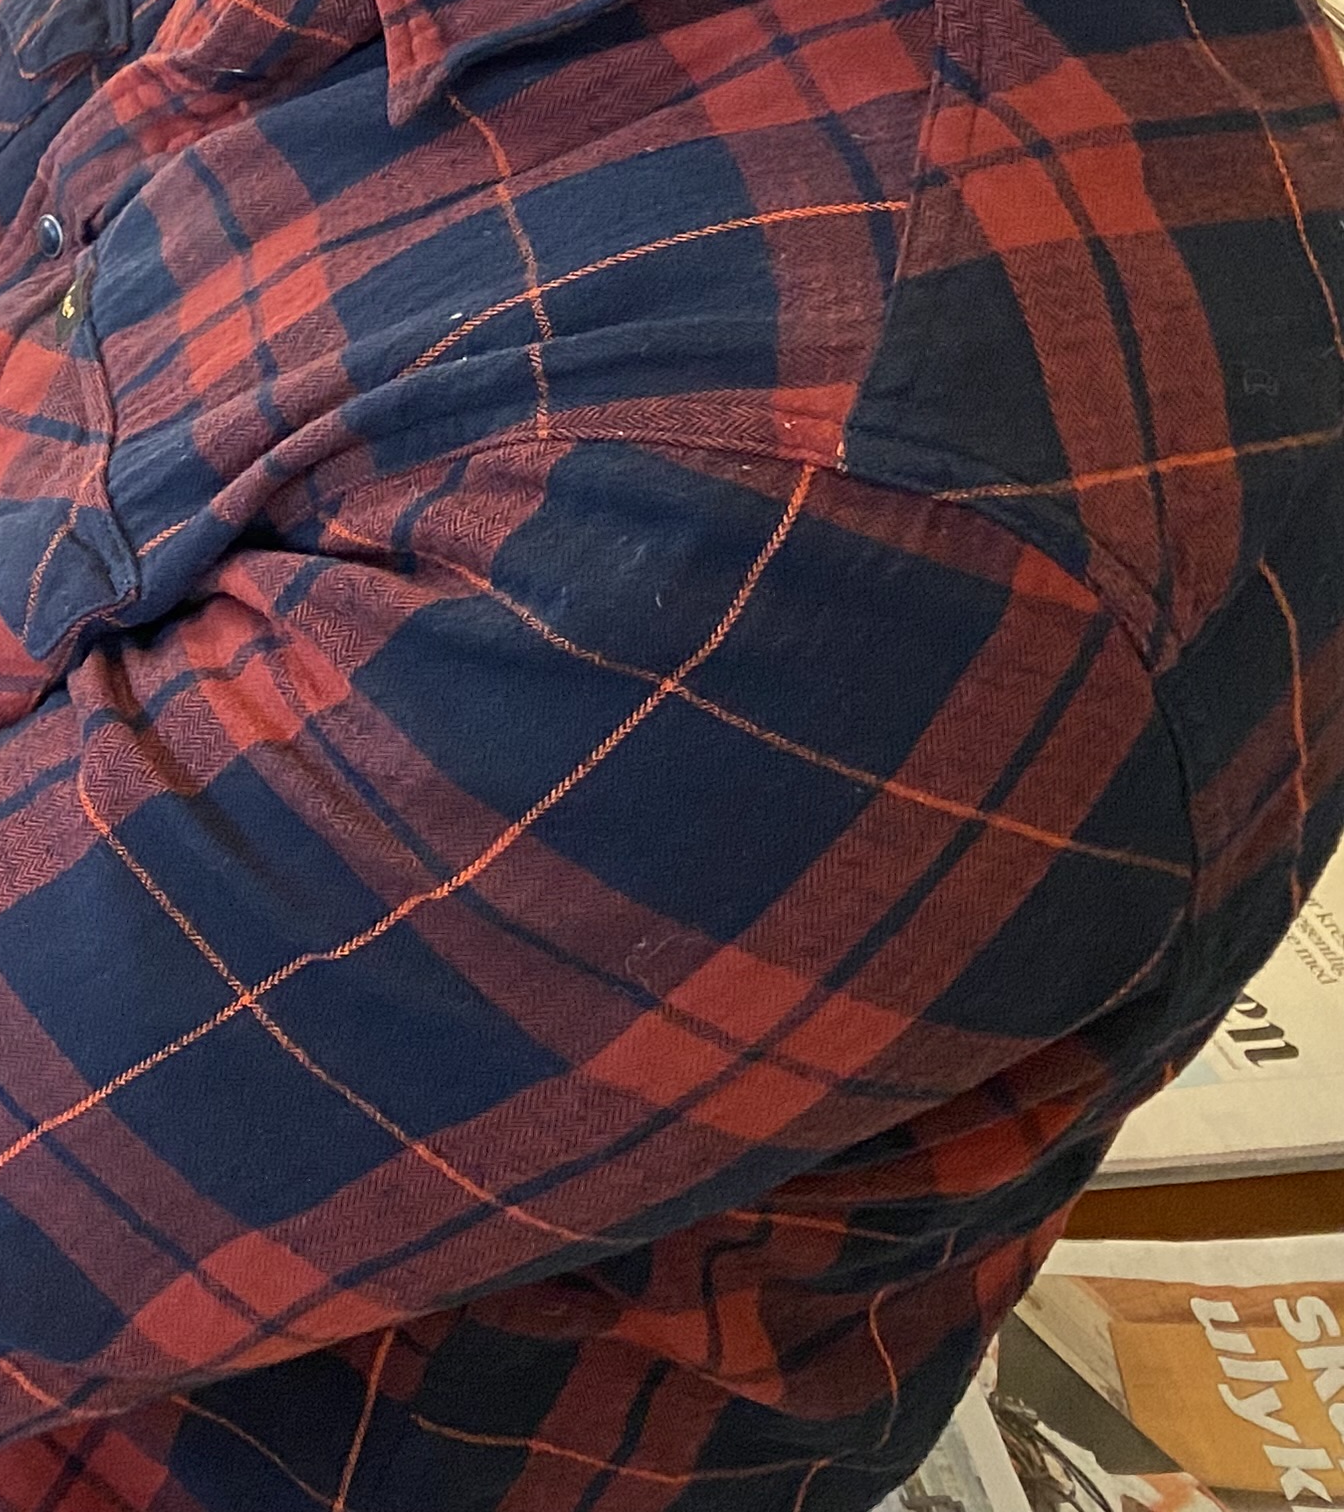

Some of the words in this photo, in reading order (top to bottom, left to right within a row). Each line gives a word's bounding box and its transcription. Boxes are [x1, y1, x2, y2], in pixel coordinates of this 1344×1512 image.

[1296, 942, 1338, 987] med
[1190, 1297, 1344, 1512] ulyk
[1273, 1295, 1344, 1448] Sk
